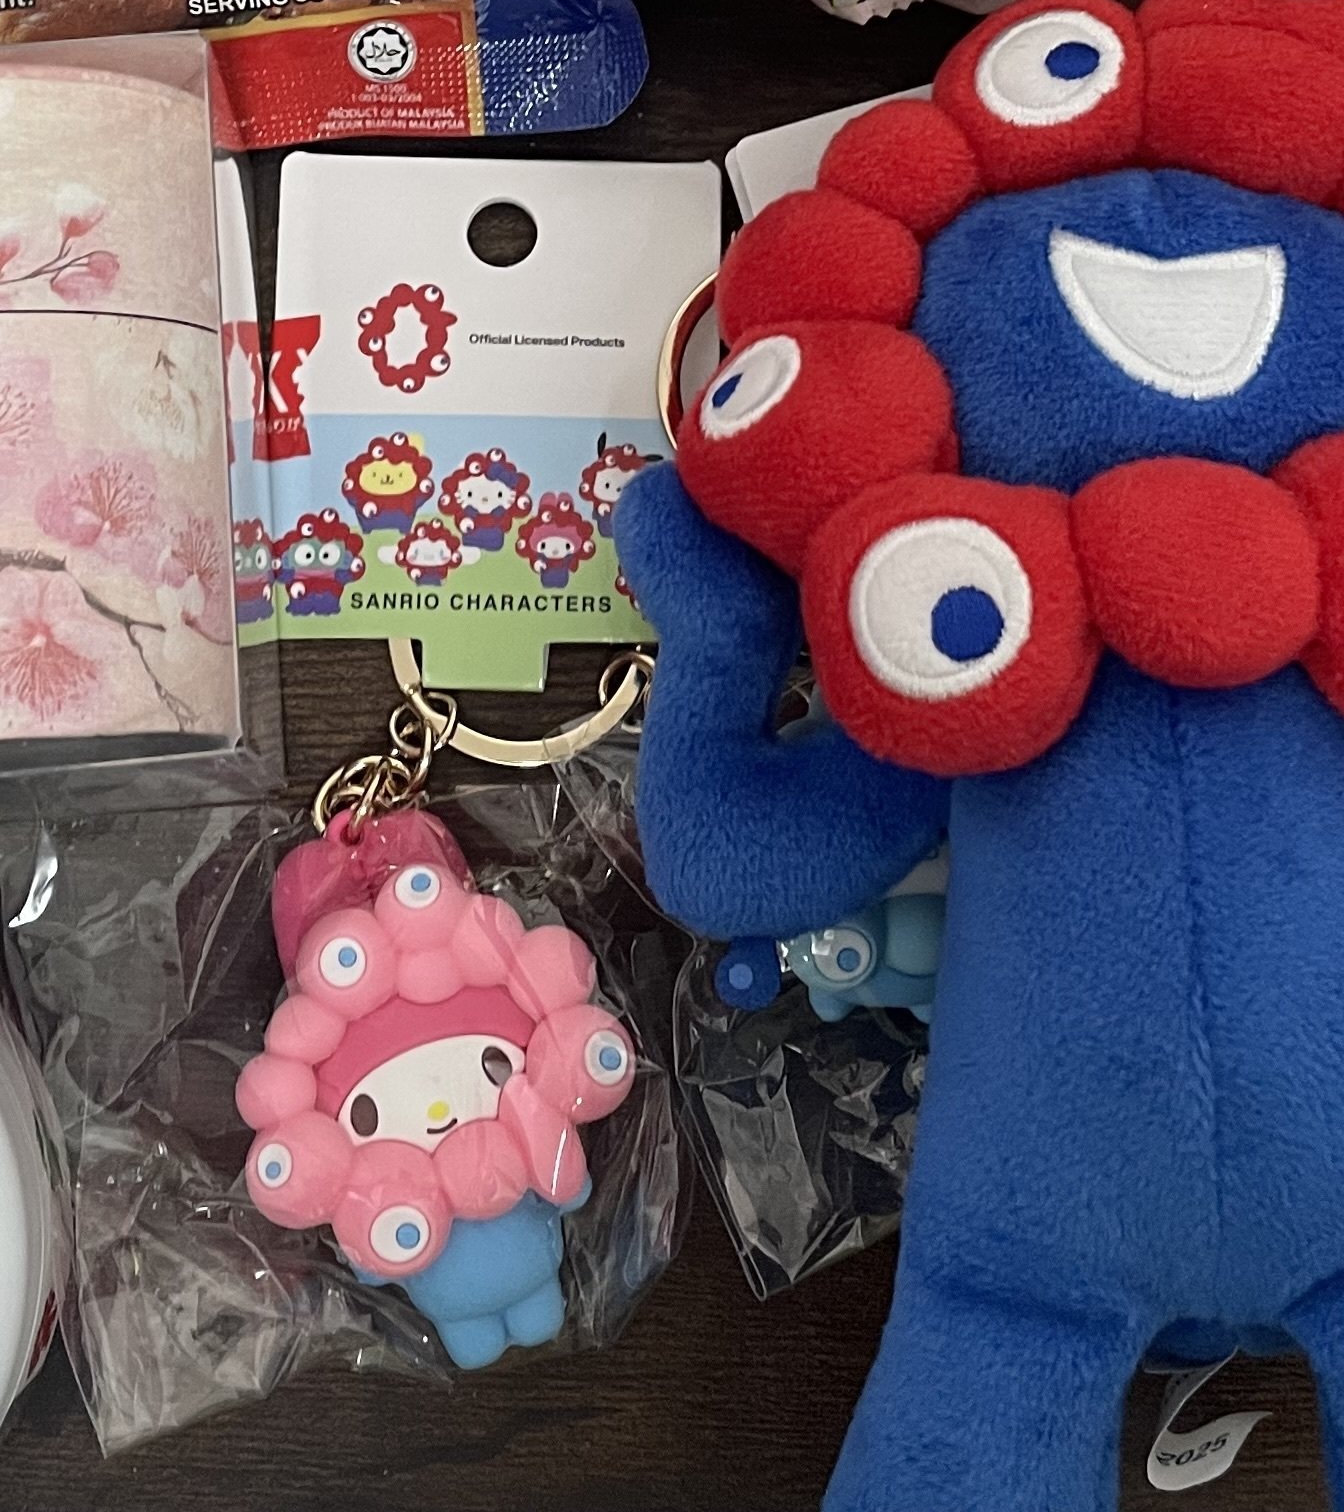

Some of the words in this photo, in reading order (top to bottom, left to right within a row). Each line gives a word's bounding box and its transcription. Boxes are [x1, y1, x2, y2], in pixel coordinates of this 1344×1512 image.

[468, 332, 513, 346] Official
[514, 333, 570, 347] Licensed
[570, 334, 626, 349] Products
[350, 591, 440, 611] SANRIO
[449, 592, 613, 614] CHARACTERS
[1155, 1431, 1231, 1468] 2025
